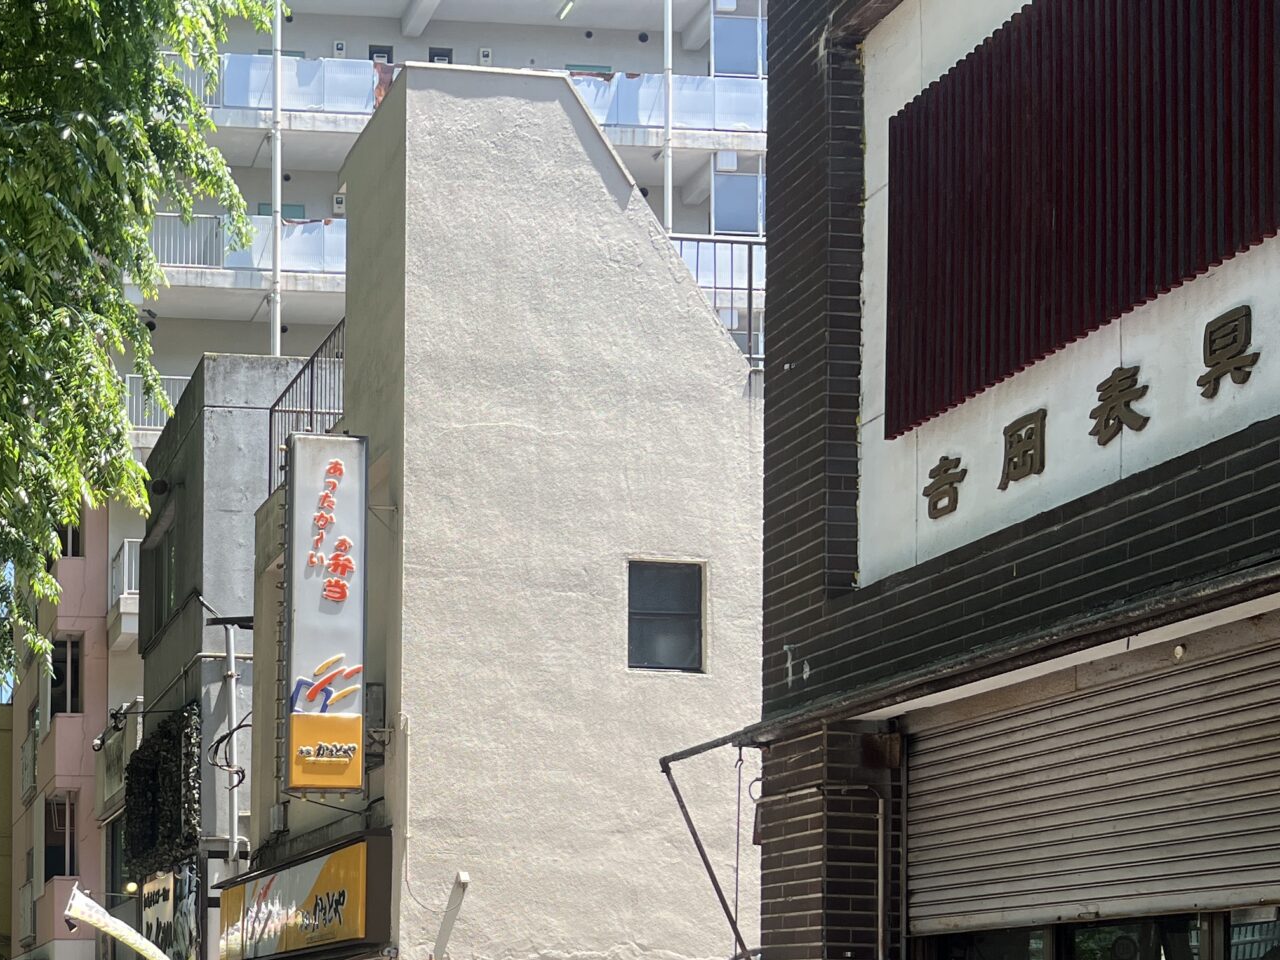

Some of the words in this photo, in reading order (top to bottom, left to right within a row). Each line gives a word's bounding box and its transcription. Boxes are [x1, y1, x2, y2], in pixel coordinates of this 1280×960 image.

[922, 304, 1261, 520] 吉岡表具
[323, 536, 356, 602] お弁当
